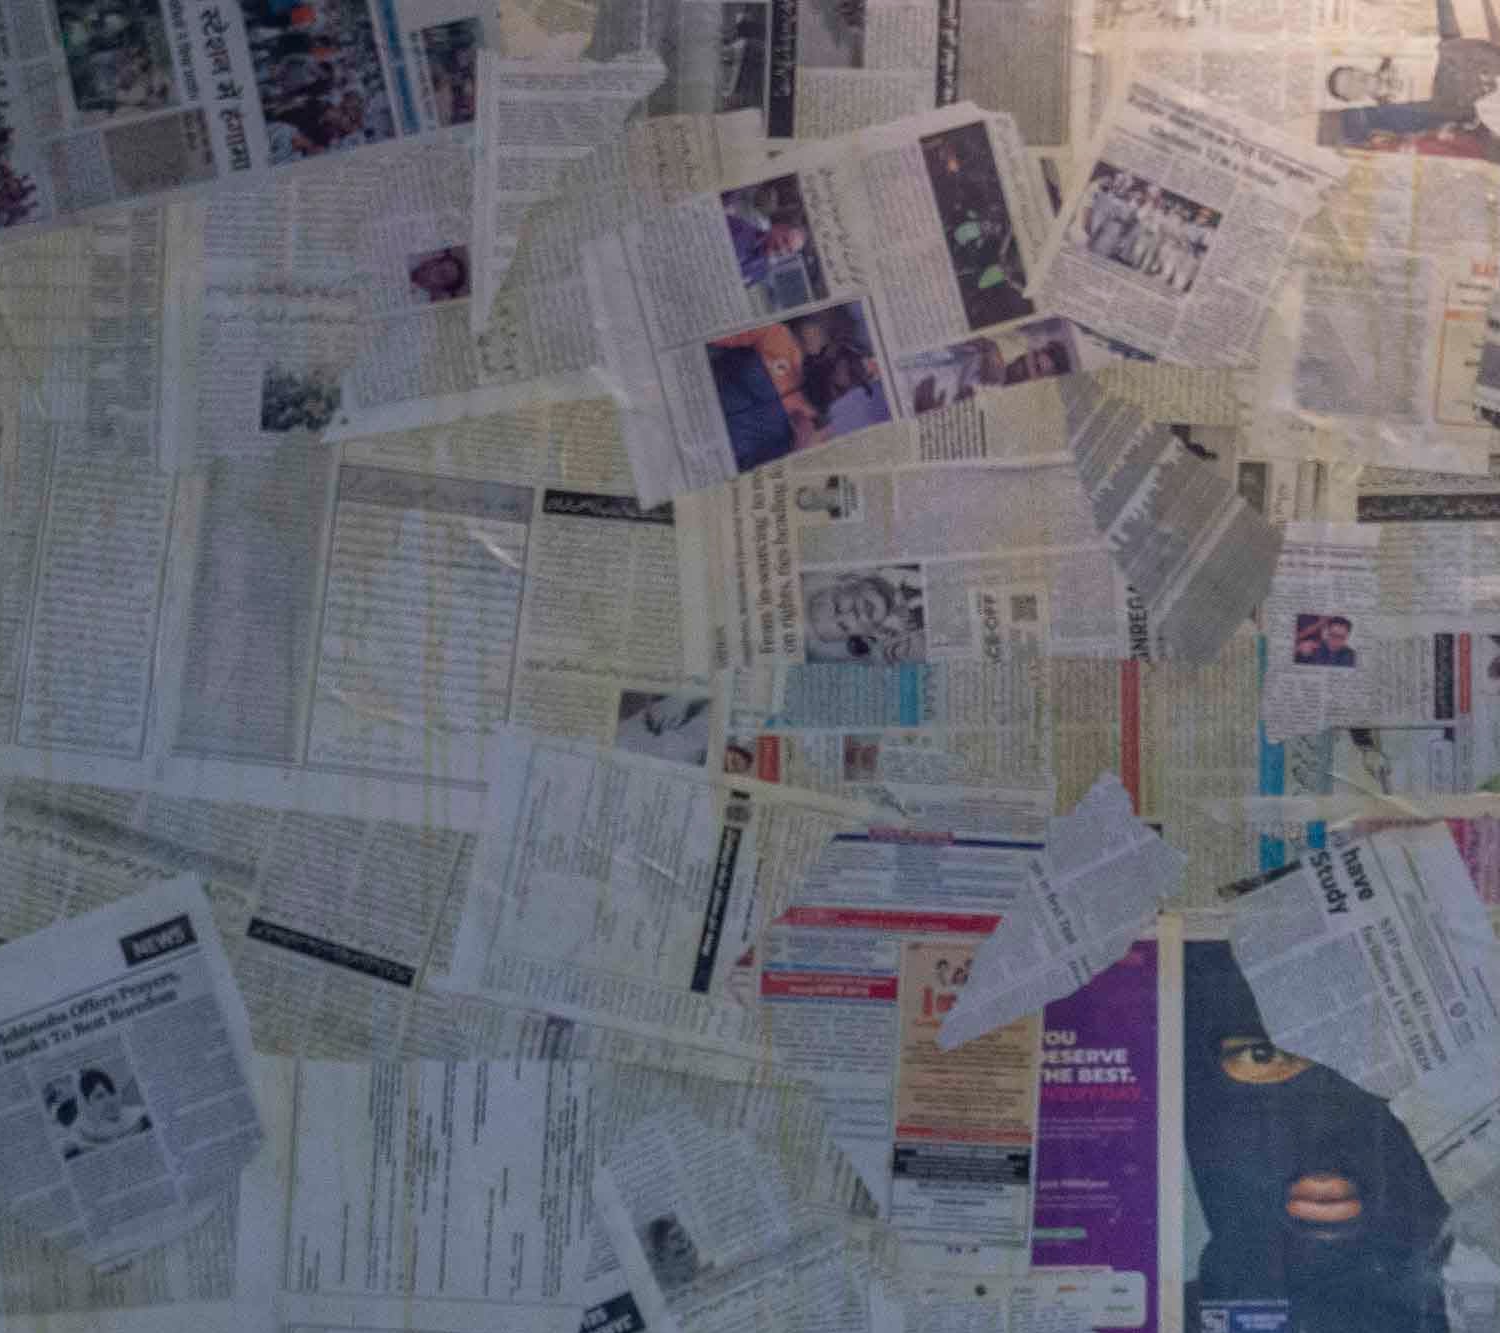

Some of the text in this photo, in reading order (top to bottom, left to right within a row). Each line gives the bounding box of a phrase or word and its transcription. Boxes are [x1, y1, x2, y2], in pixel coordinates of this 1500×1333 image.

[218, 80, 241, 100] में
[128, 917, 188, 958] NEWS
[1077, 1067, 1137, 1084] BEST.
